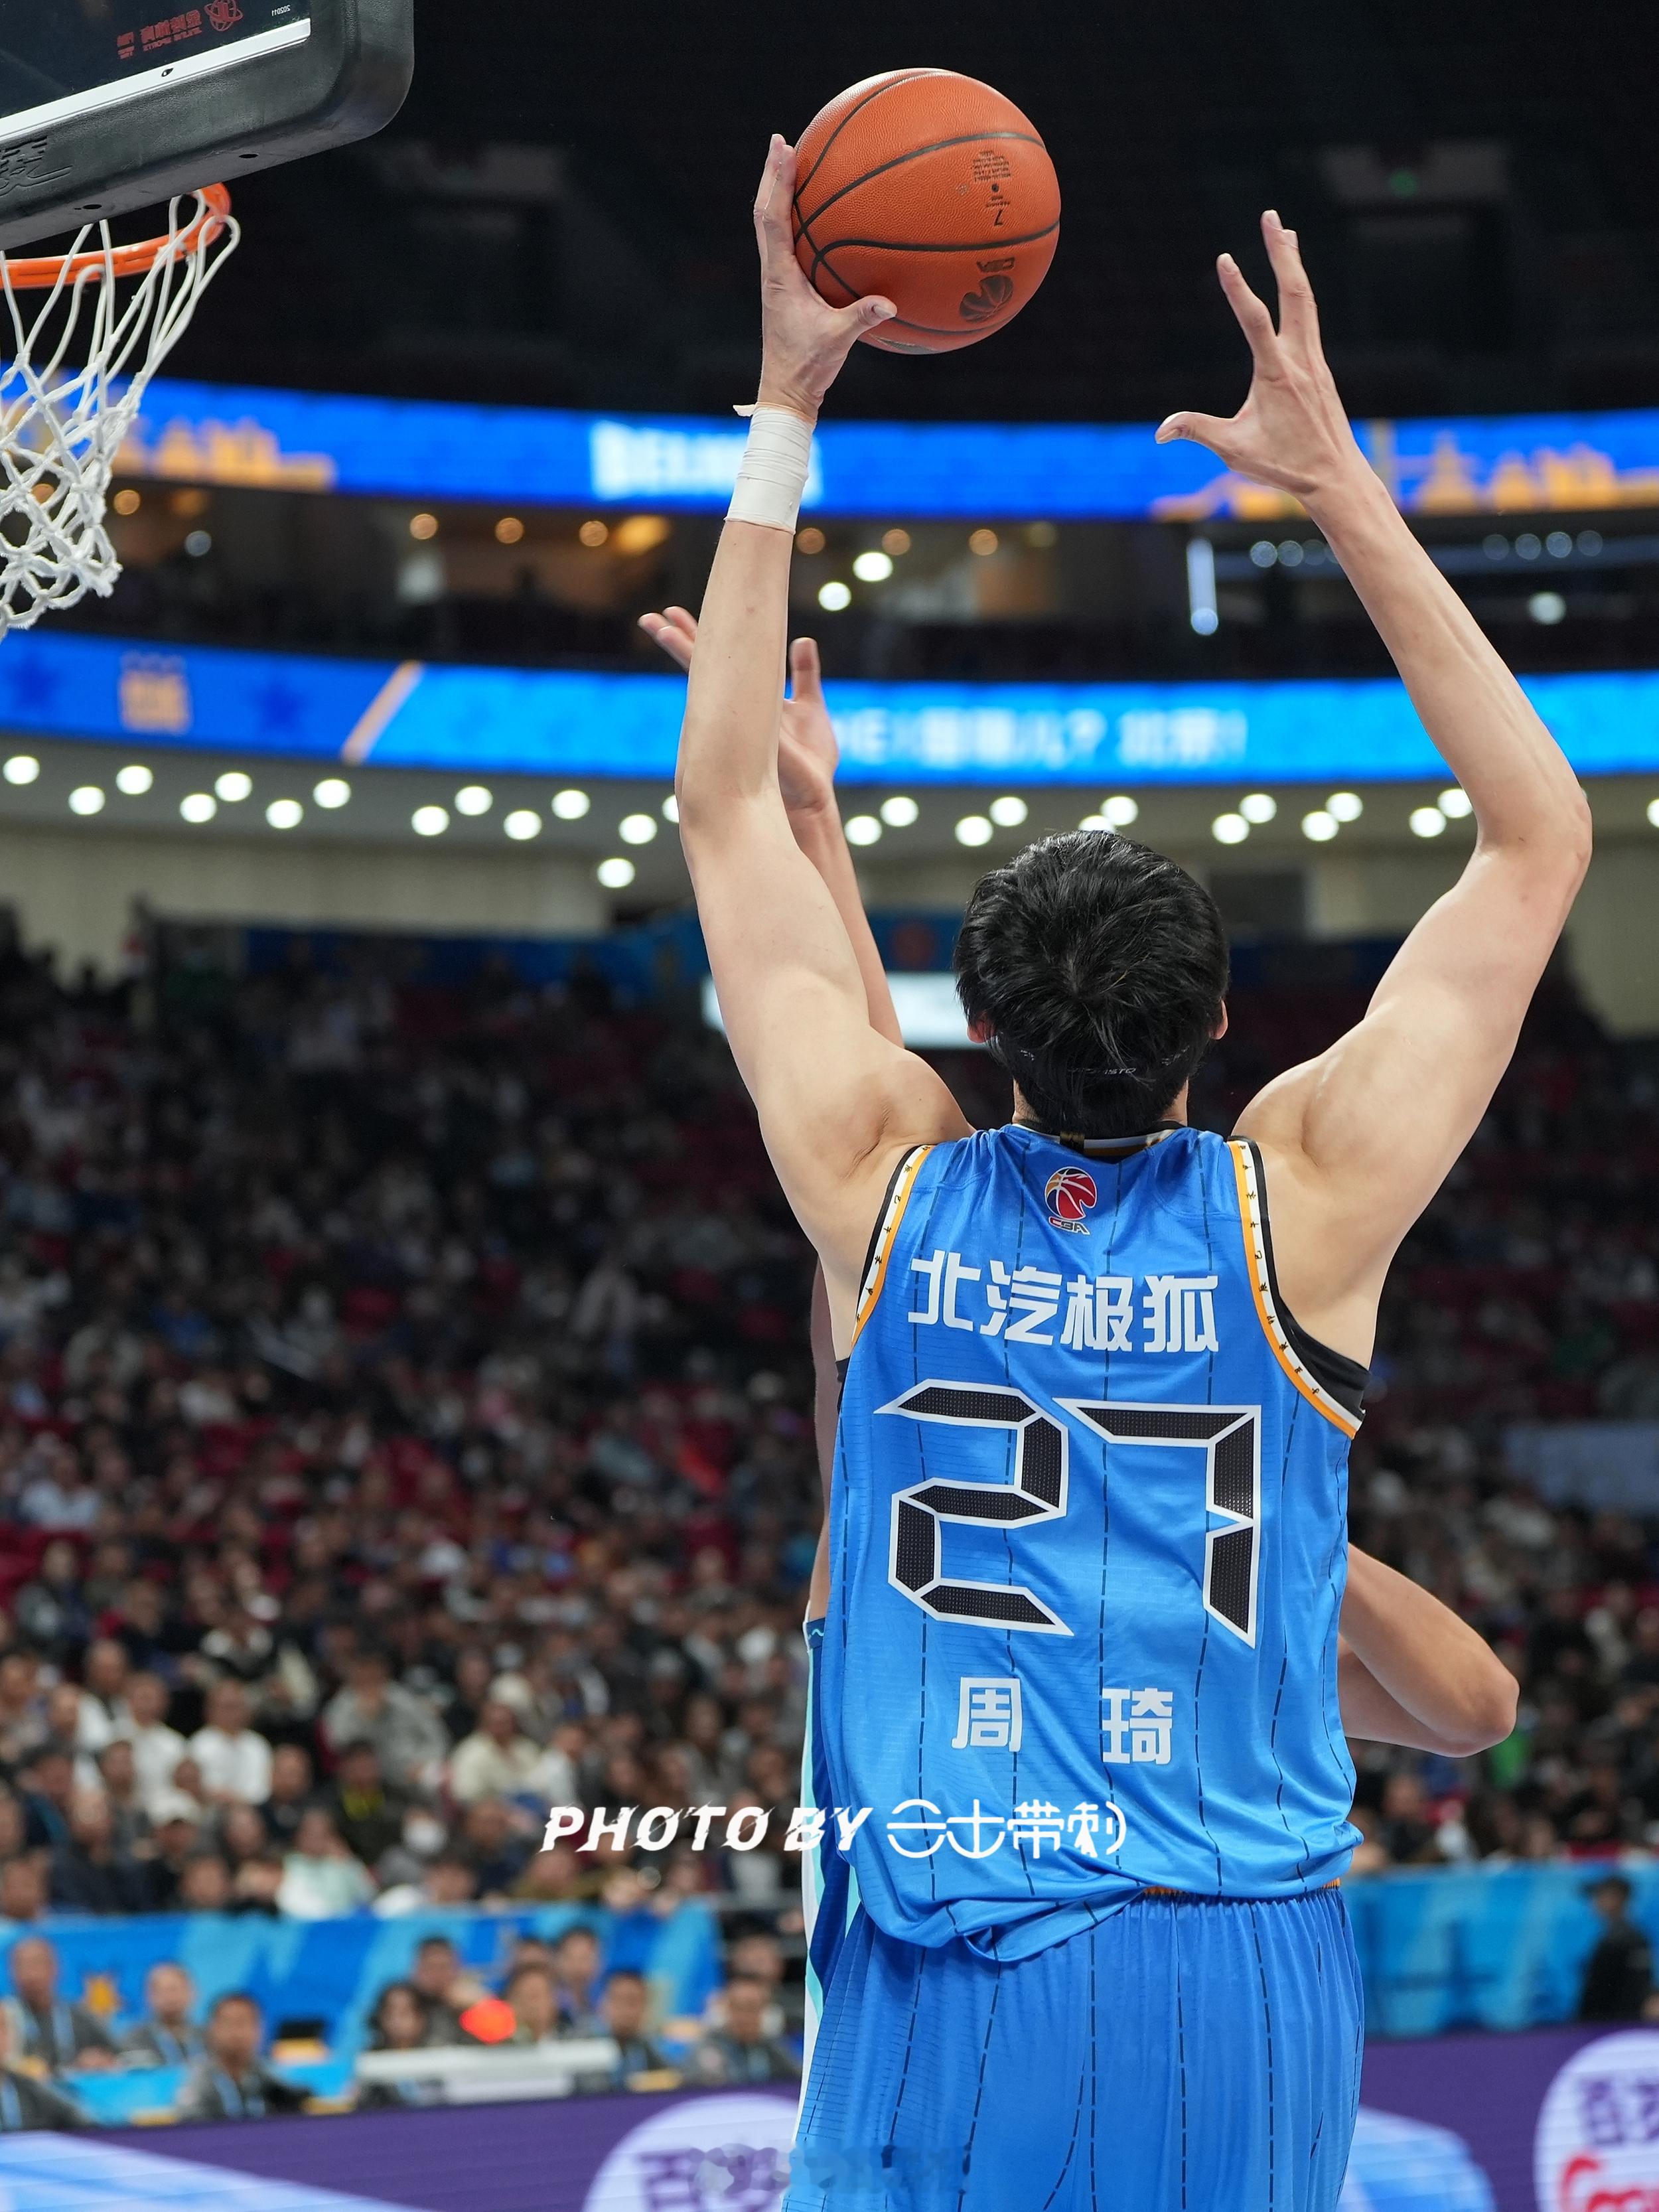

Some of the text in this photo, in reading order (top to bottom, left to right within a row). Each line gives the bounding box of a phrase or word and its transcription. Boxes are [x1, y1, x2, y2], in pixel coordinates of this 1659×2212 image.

[994, 209, 1004, 226] 7
[1048, 1216, 1090, 1235] CBA
[907, 1248, 1219, 1353] 北汽极狐
[873, 1378, 1262, 1650] 27
